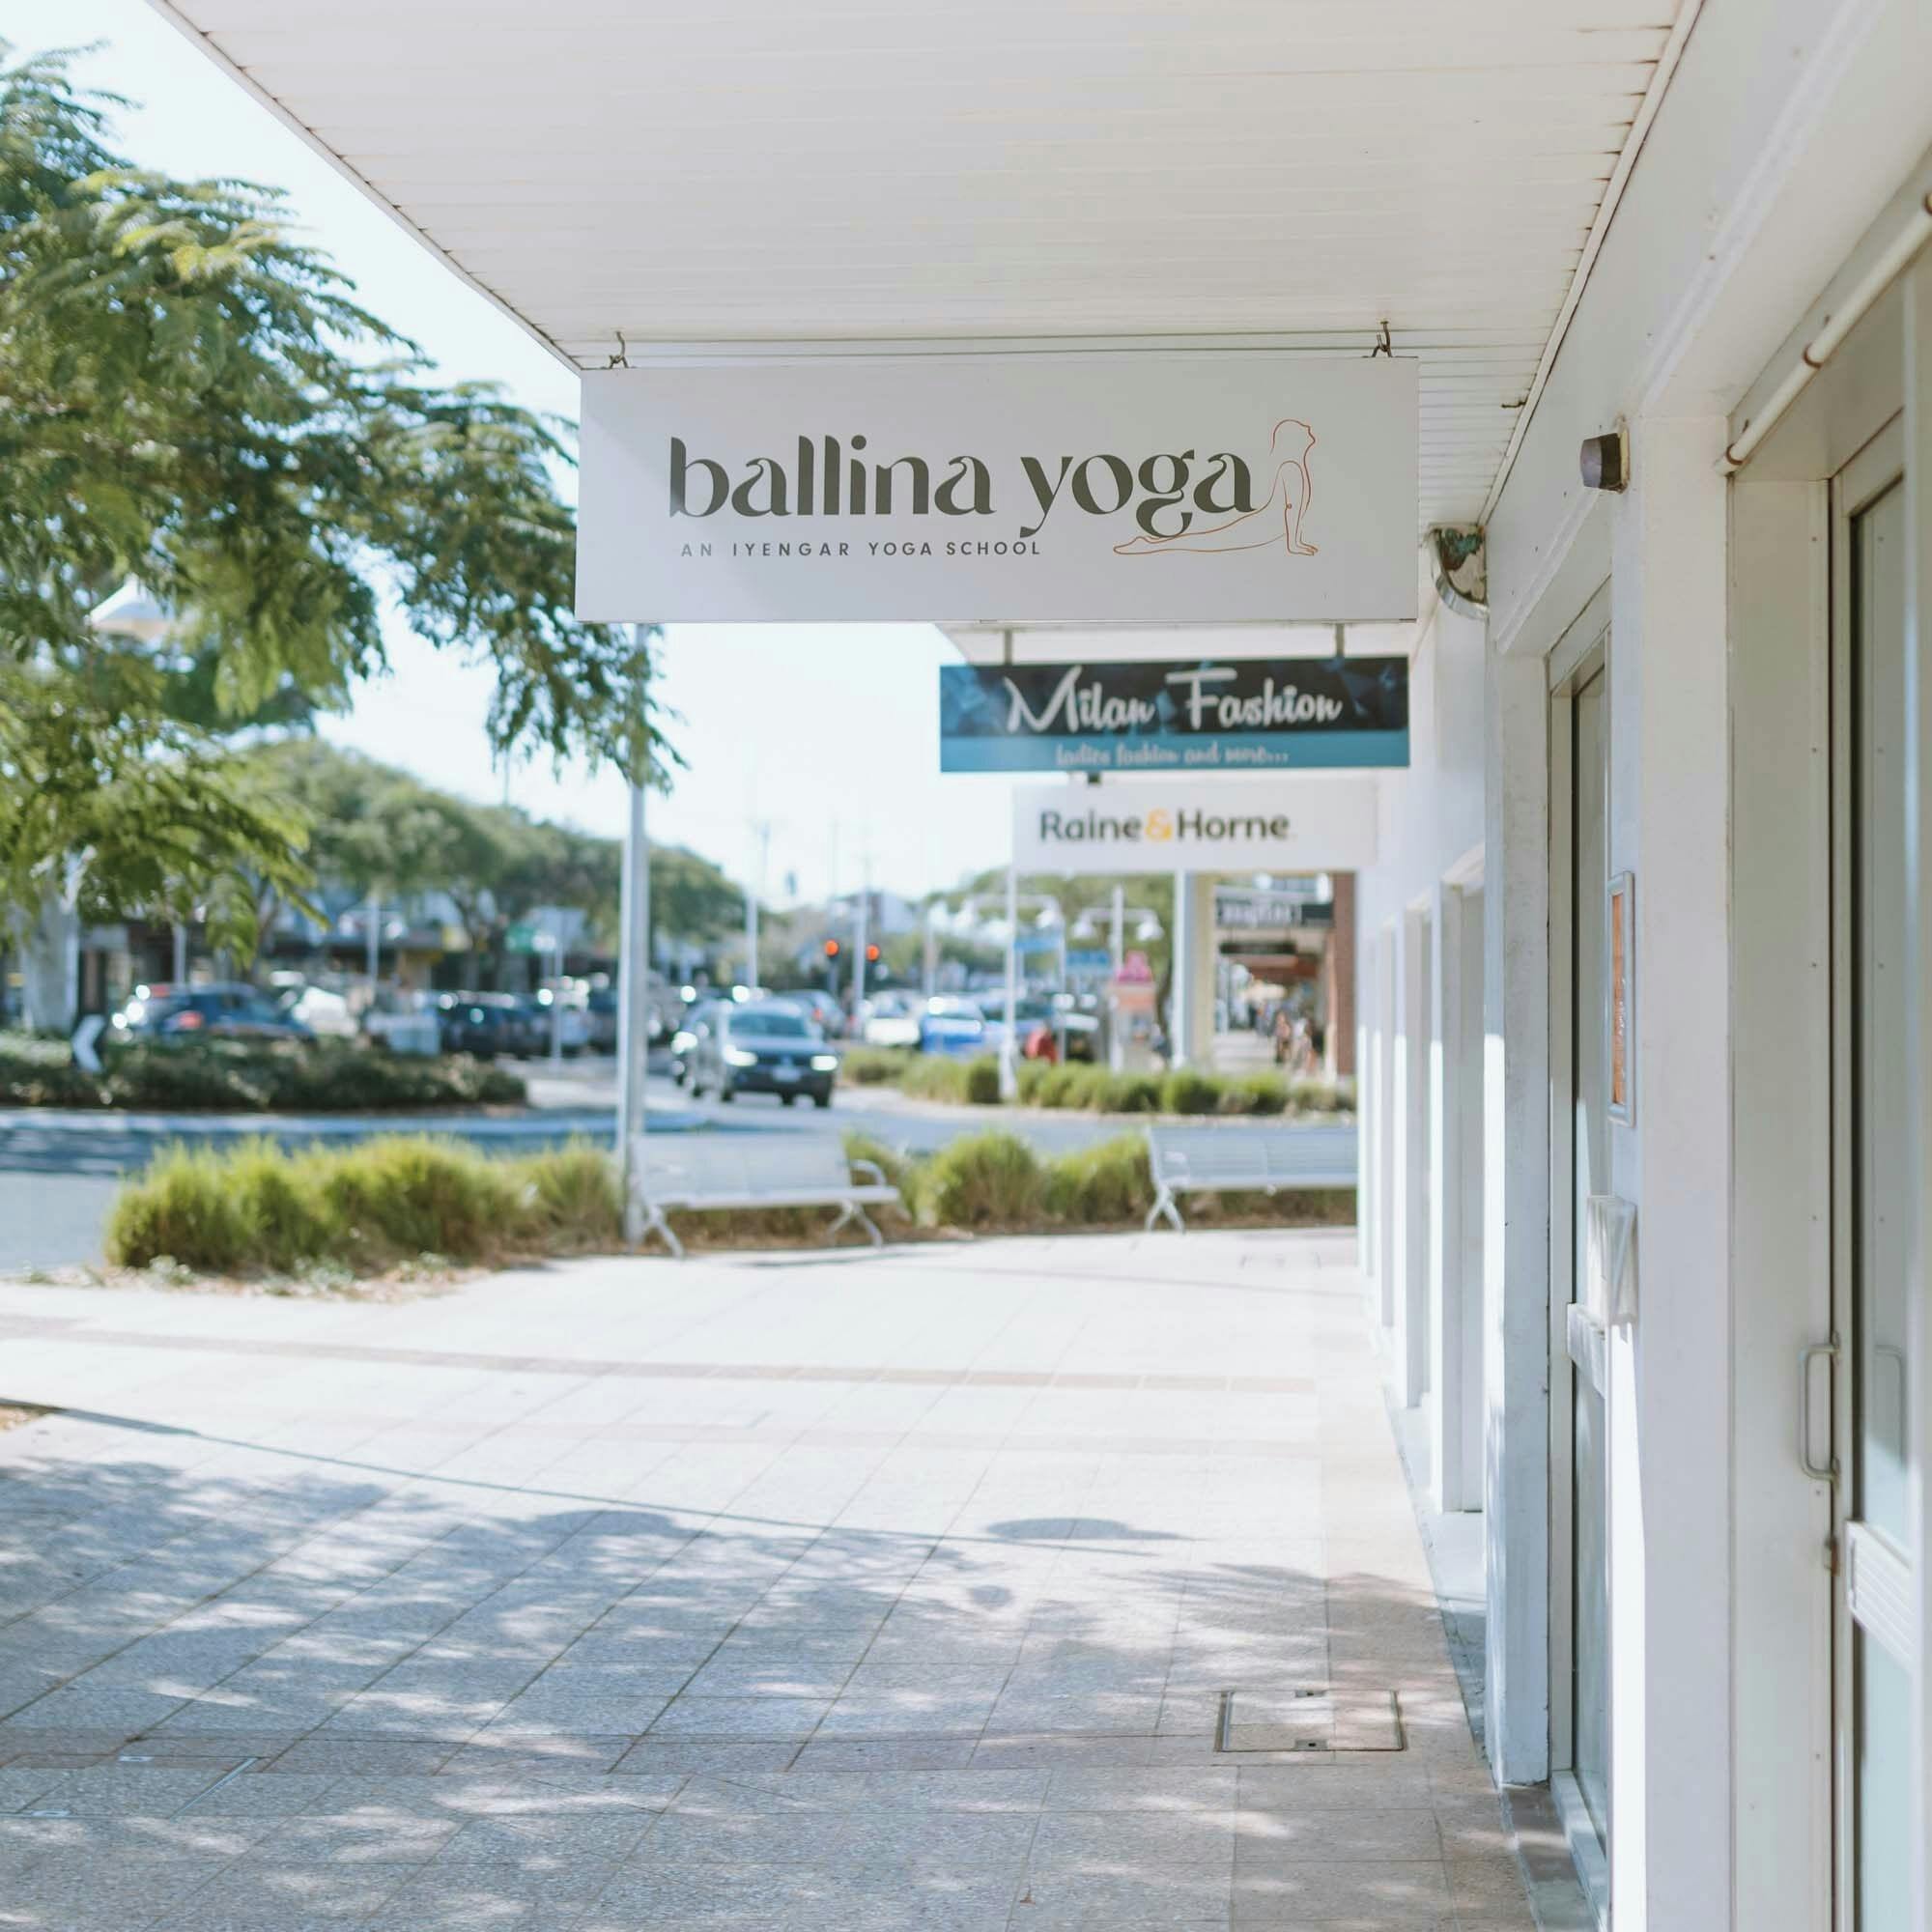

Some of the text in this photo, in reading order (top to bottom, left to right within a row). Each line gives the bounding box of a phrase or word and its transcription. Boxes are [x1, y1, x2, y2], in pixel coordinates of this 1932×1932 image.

[669, 434, 1258, 538] ballina yoga
[681, 541, 1040, 557] AN IYENGAR YOGA SCHOOL
[1004, 666, 1343, 734] Milan Fashion
